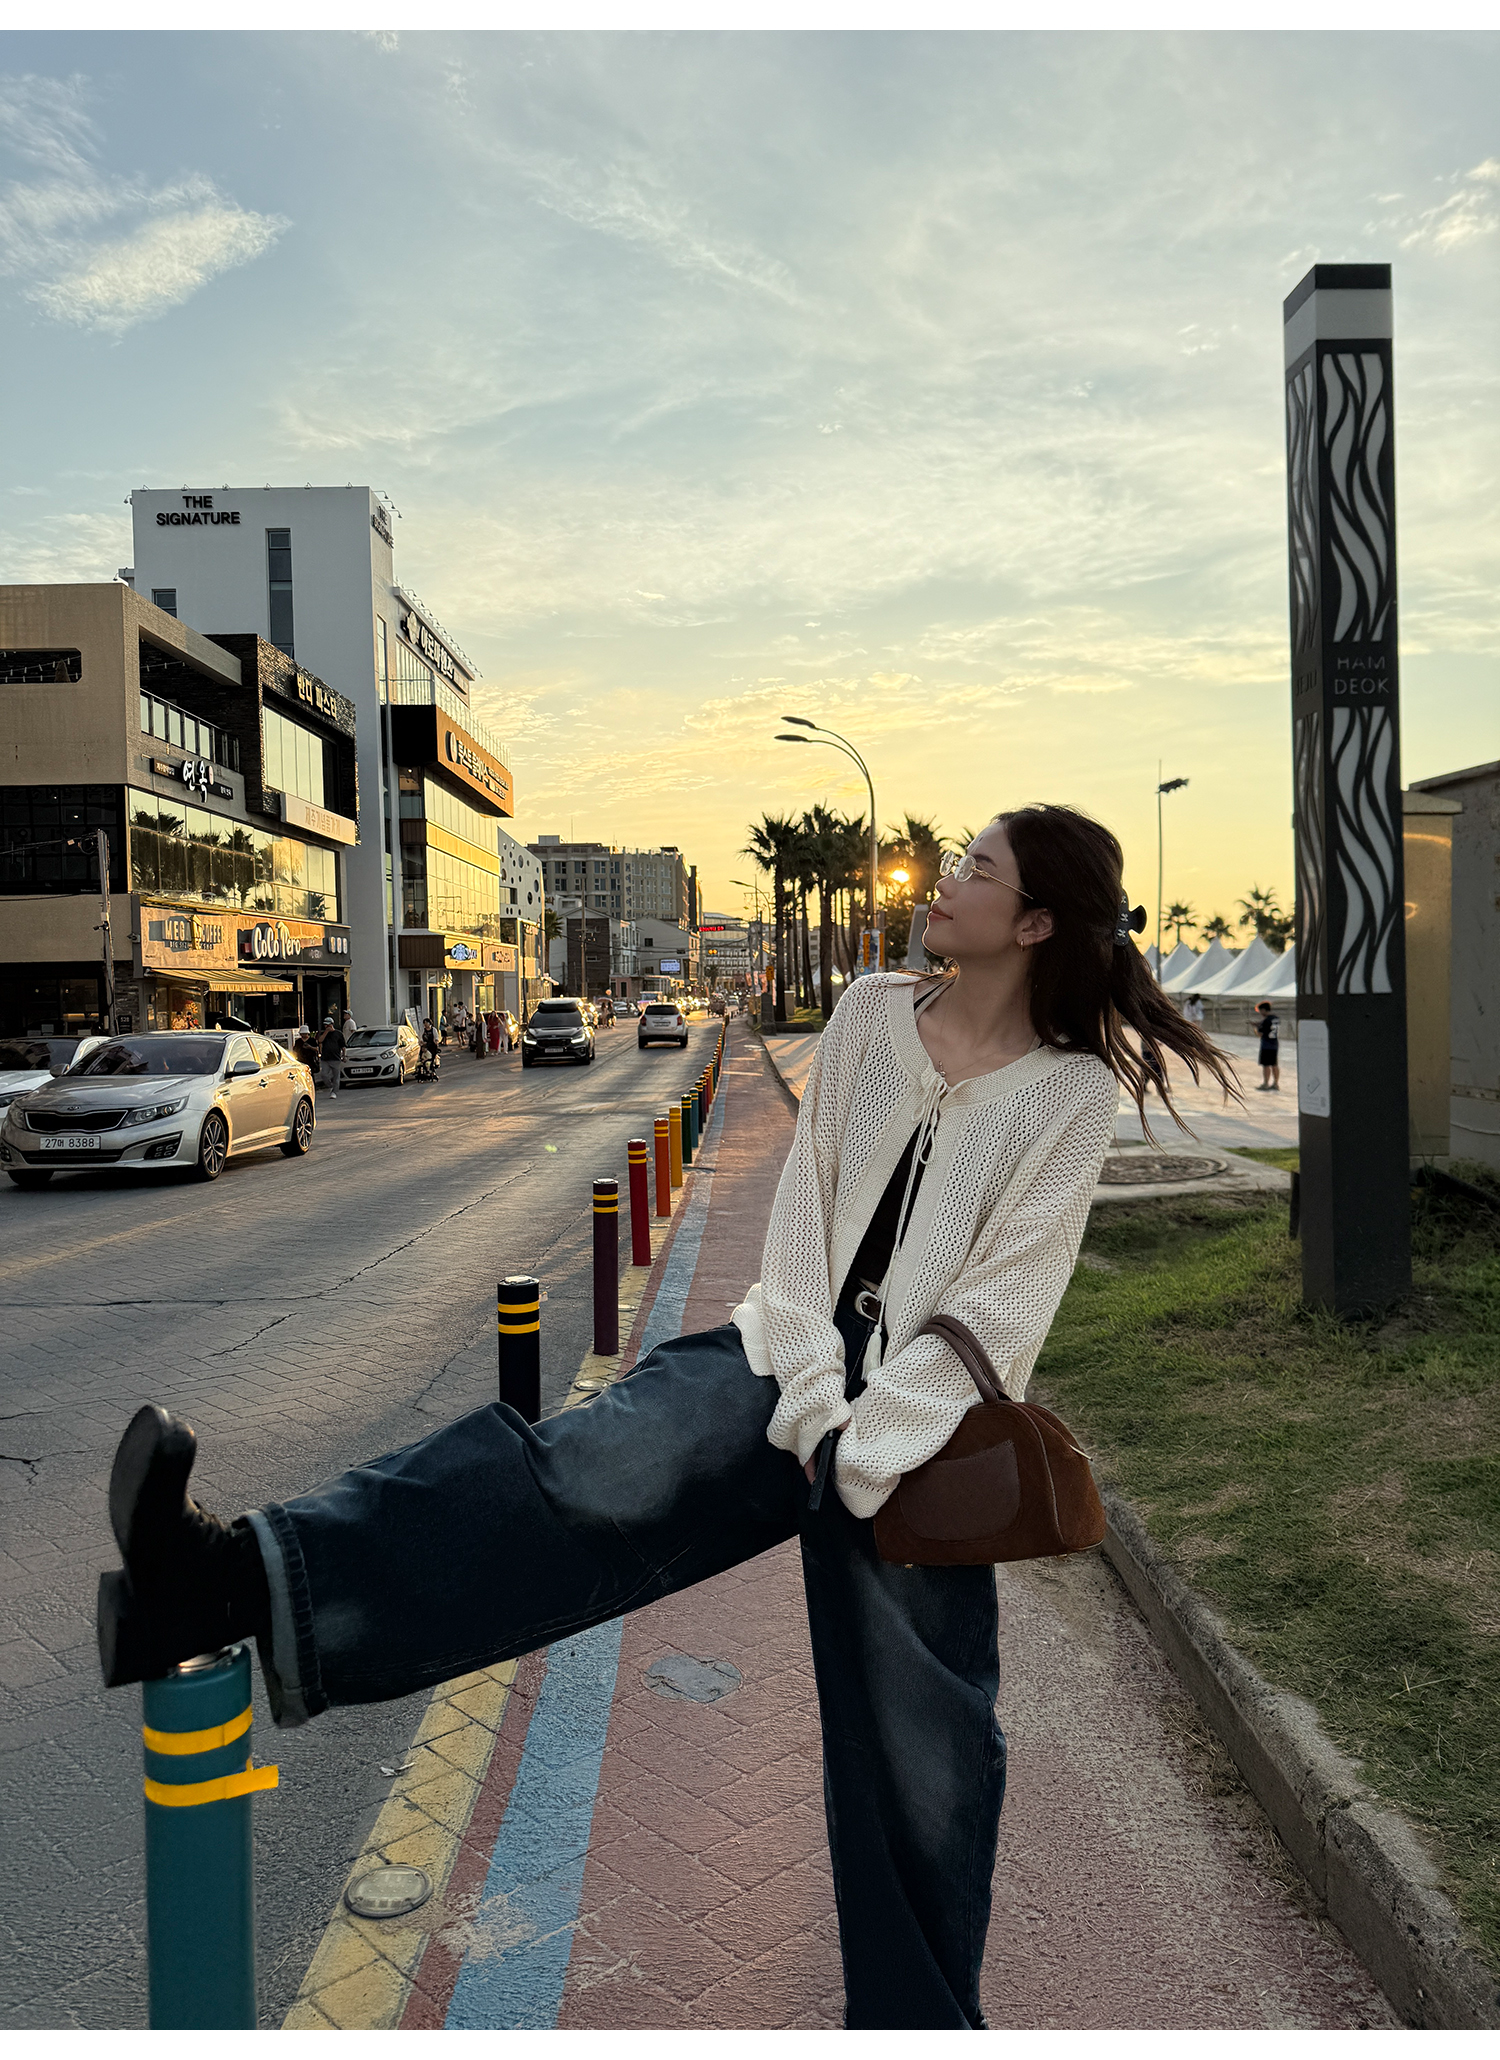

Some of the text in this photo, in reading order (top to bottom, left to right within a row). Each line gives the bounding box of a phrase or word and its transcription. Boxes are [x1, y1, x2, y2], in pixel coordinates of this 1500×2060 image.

[182, 495, 213, 508] THE
[156, 511, 241, 526] SIGNATURE
[1337, 656, 1385, 670] HAM
[1334, 677, 1390, 695] DEOK
[296, 672, 338, 721] 반디 파스타
[45, 1138, 95, 1148] 27어 8388
